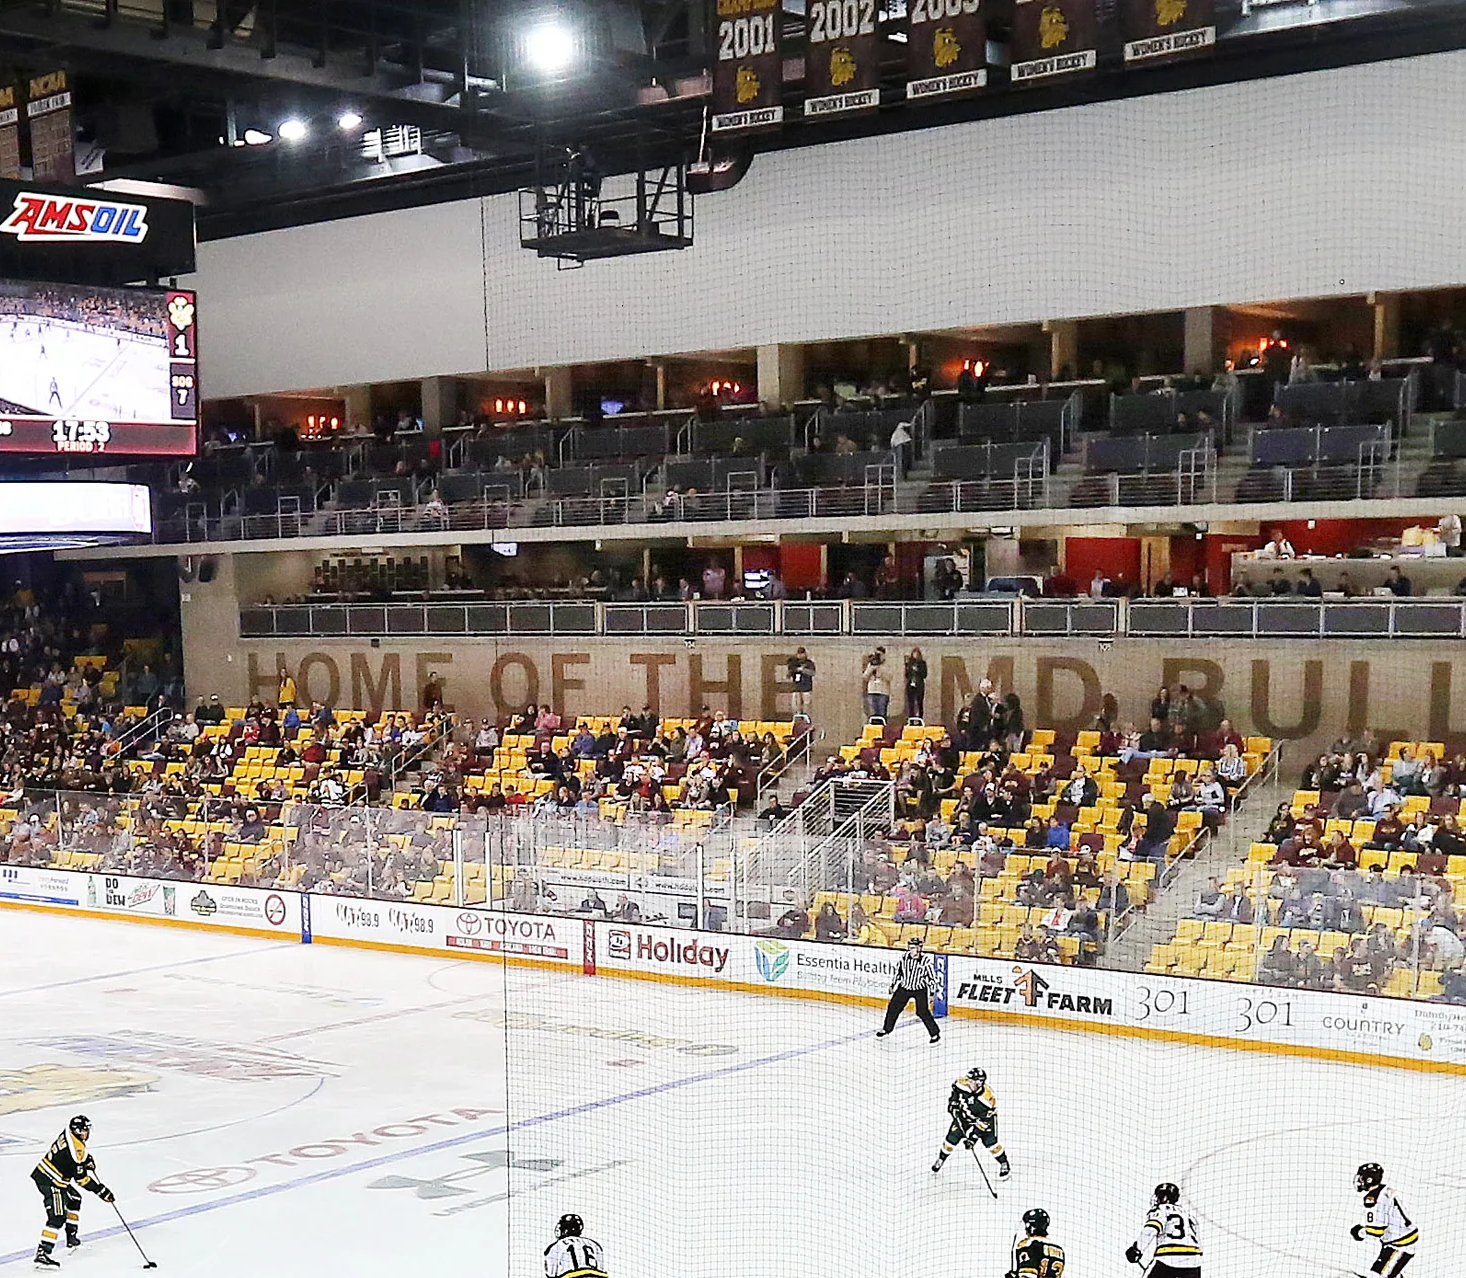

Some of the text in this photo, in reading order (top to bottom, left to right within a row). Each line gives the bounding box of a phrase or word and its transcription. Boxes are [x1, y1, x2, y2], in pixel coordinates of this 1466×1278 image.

[809, 0, 875, 43] 2002
[719, 14, 775, 60] 2001
[7, 196, 146, 237] AMSOIL
[174, 334, 189, 356] 1
[178, 389, 188, 405] 7
[52, 421, 110, 443] 17:53
[57, 441, 105, 452] PERIOD 2
[247, 652, 453, 712] HOME
[489, 652, 591, 712] OF
[630, 652, 798, 722] THE
[105, 877, 119, 889] DO
[106, 893, 126, 906] DEW
[484, 916, 557, 941] TOYOTA
[637, 934, 730, 973] Holiday
[797, 953, 897, 976] Essentia Health
[973, 973, 1003, 984] MILLS
[956, 982, 1113, 1016] FLEET FARM
[1135, 985, 1190, 1021] 301
[1235, 997, 1294, 1033] 301
[243, 1106, 506, 1167] TOYOTA
[566, 1244, 598, 1270] 16
